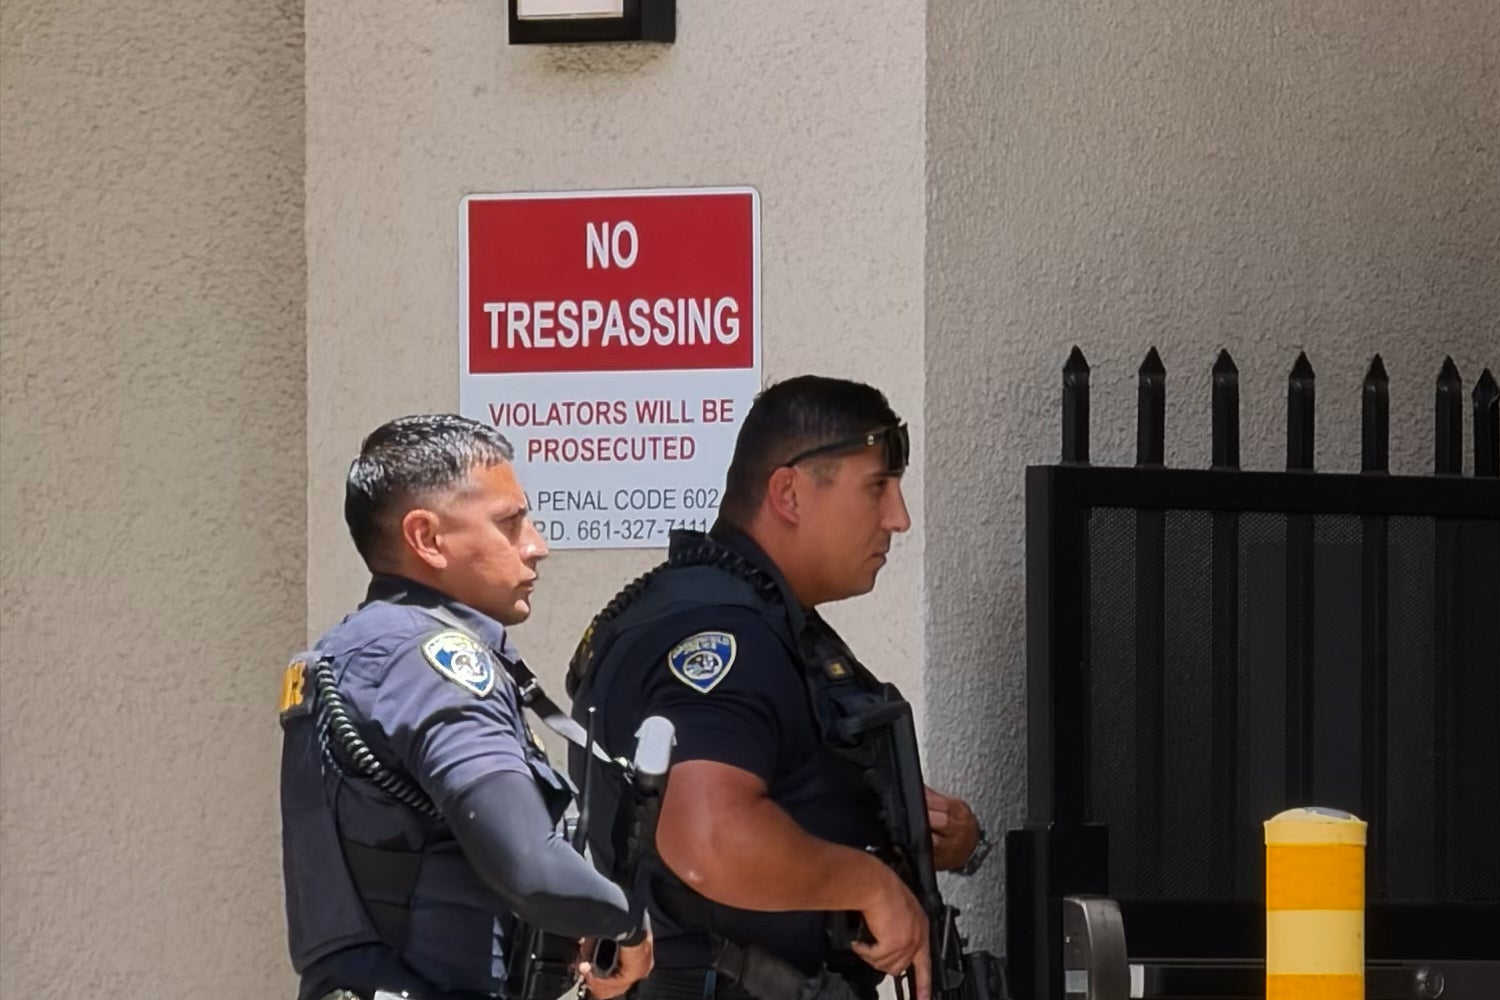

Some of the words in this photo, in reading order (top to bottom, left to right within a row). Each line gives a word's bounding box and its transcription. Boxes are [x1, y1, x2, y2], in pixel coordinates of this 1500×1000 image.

[586, 220, 639, 269] NO
[483, 297, 740, 349] TRESPASSING
[489, 401, 627, 427] VIOLATORS
[635, 400, 694, 424] WILL
[702, 399, 735, 423] BE
[528, 436, 696, 463] PROSECUTED
[538, 490, 608, 511] PENAL
[614, 489, 676, 510] CODE
[683, 488, 719, 509] 602
